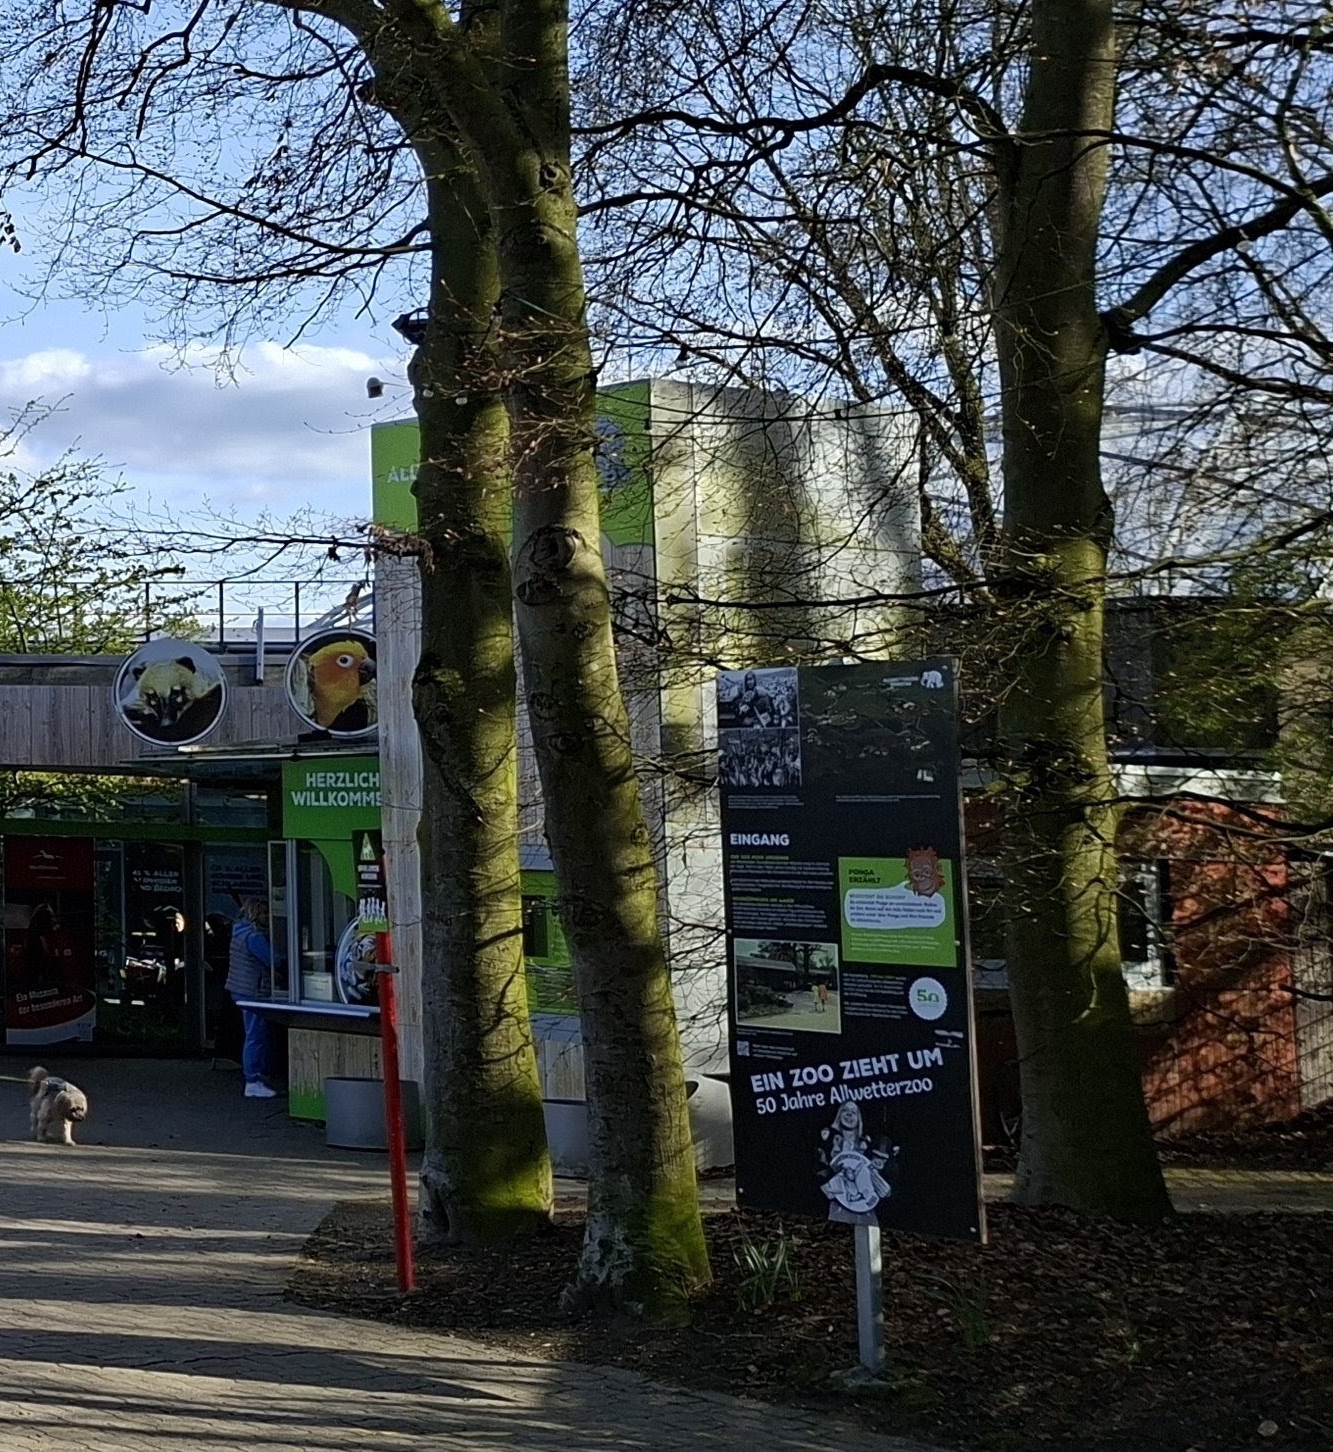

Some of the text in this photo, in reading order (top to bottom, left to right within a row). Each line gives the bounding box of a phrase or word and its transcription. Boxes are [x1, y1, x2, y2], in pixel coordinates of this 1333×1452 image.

[305, 772, 380, 788] HERZLICH
[290, 791, 383, 807] WILLKOMME
[729, 833, 790, 847] EINGANG
[750, 1047, 945, 1093] EIN ZOO ZIEHT UM
[756, 1077, 933, 1115] 50 Jahre Allwetterzoo
